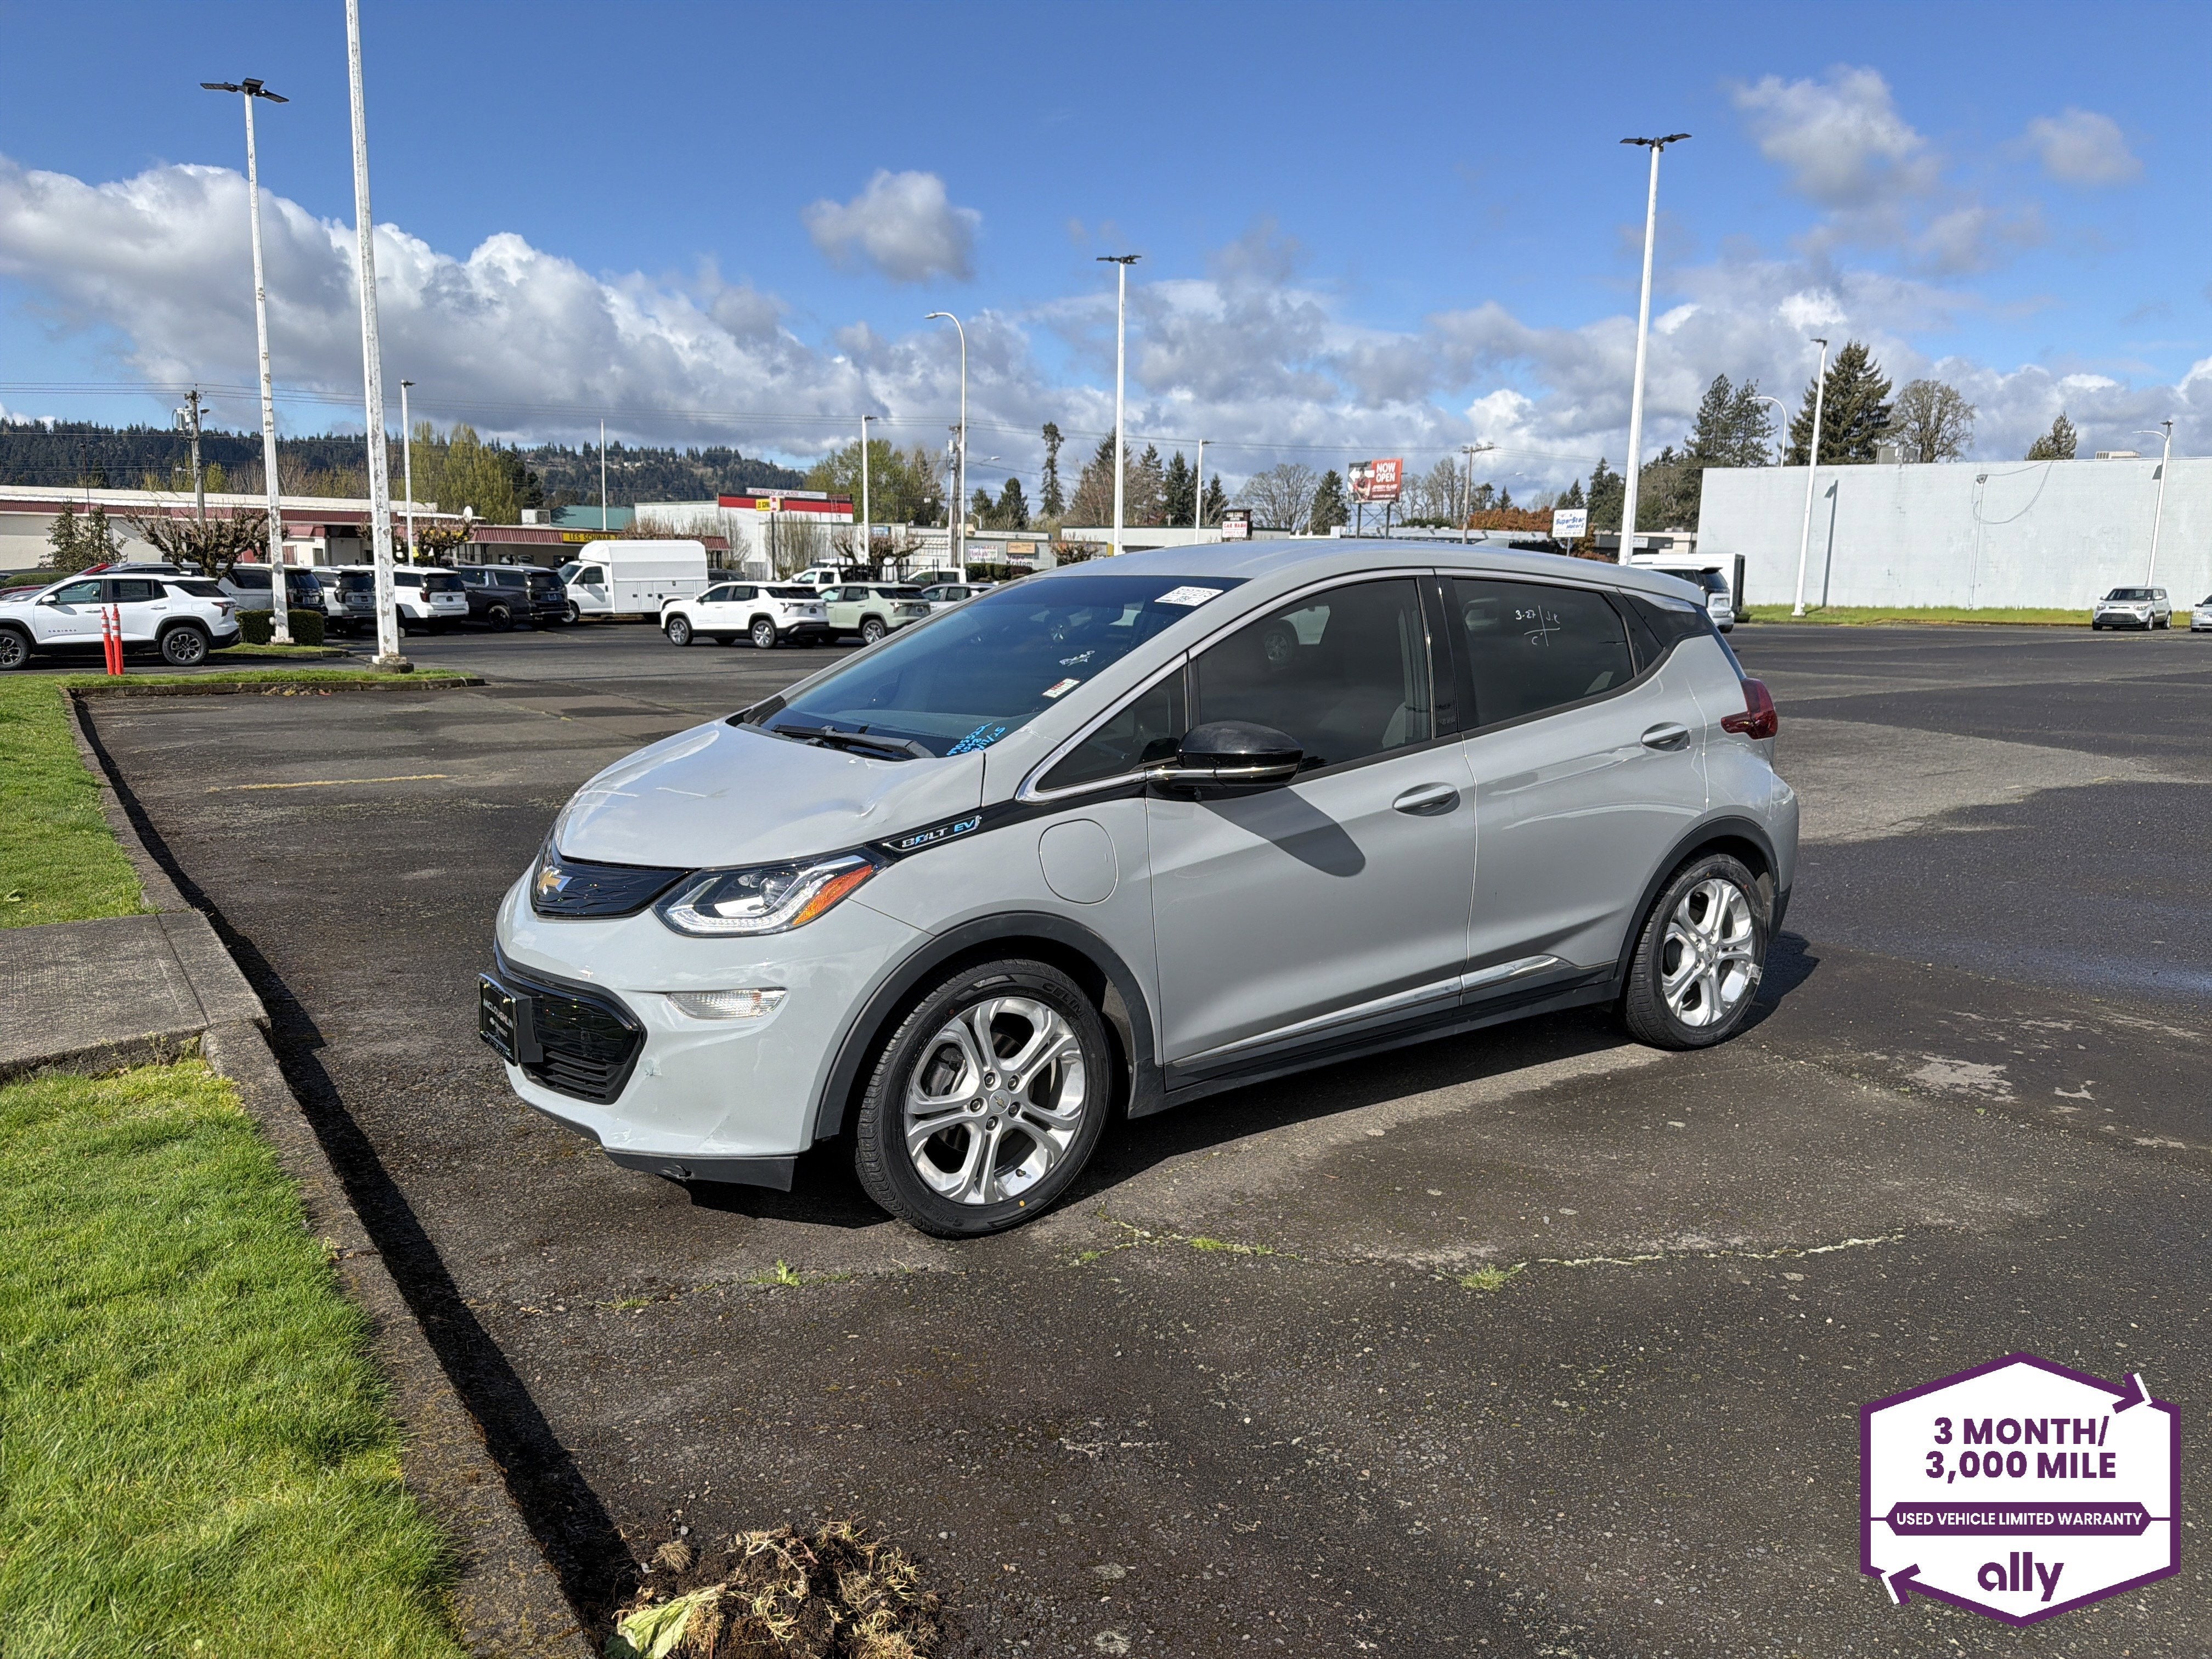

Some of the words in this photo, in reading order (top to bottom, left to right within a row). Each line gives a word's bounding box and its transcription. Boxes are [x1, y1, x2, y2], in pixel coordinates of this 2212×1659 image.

[1376, 461, 1396, 473] NOW
[1375, 472, 1396, 483] OPEN
[901, 827, 949, 848] BOLT
[954, 819, 975, 832] EV
[483, 997, 514, 1030] MCLOUGHLIN
